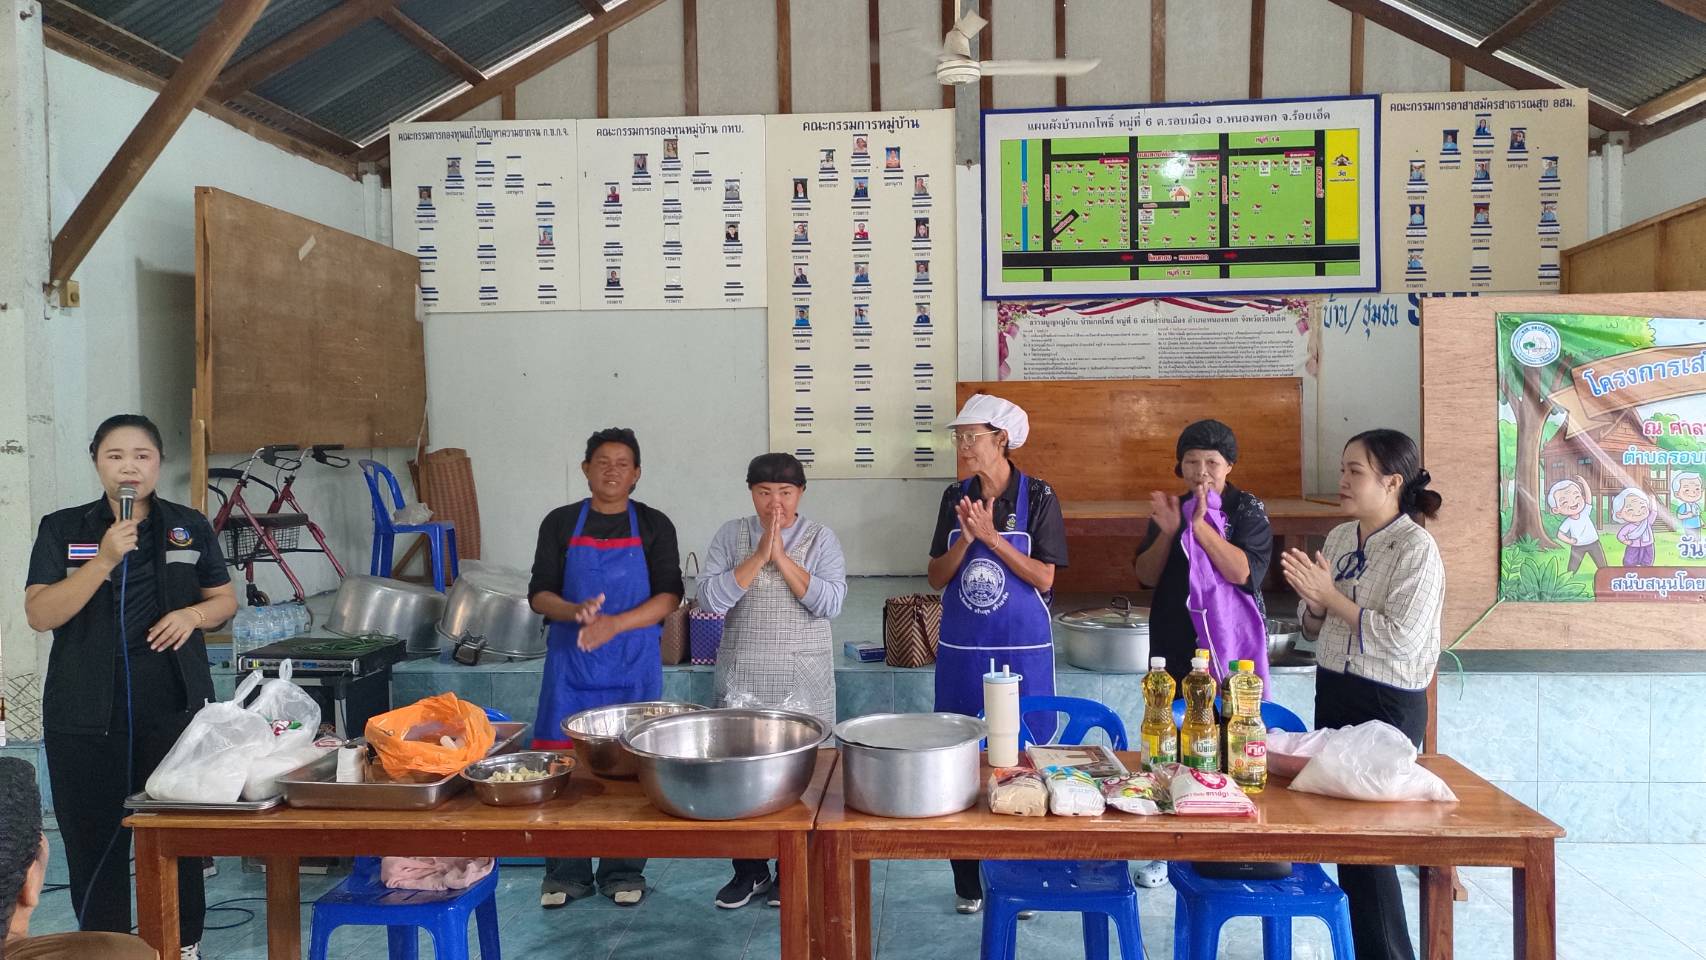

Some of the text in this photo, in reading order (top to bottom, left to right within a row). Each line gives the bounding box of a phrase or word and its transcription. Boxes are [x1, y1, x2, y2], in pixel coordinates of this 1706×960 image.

[1390, 97, 1576, 112] คณะกรรมการอาสาสมัครสาธารณสุข อสม.
[802, 115, 921, 134] คณะกรรมการหมู่บ้าน
[1027, 114, 1114, 131] แผนผังบ้านกกโพธิ์
[1145, 117, 1153, 127] 6
[1157, 113, 1211, 127] ต.รอบเมือง
[1216, 112, 1278, 124] อ.หนองพอก
[1282, 107, 1331, 122] จ.ร้อยเอ็ด
[596, 123, 718, 139] คณะกรรมการกองทุนหมู่บ้าน
[1583, 352, 1706, 397] โครงการเส
[1643, 419, 1706, 436] ณ ศาล
[1623, 445, 1706, 466] ตำบลรอบ
[1611, 570, 1706, 598] สนับสนุนโดย
